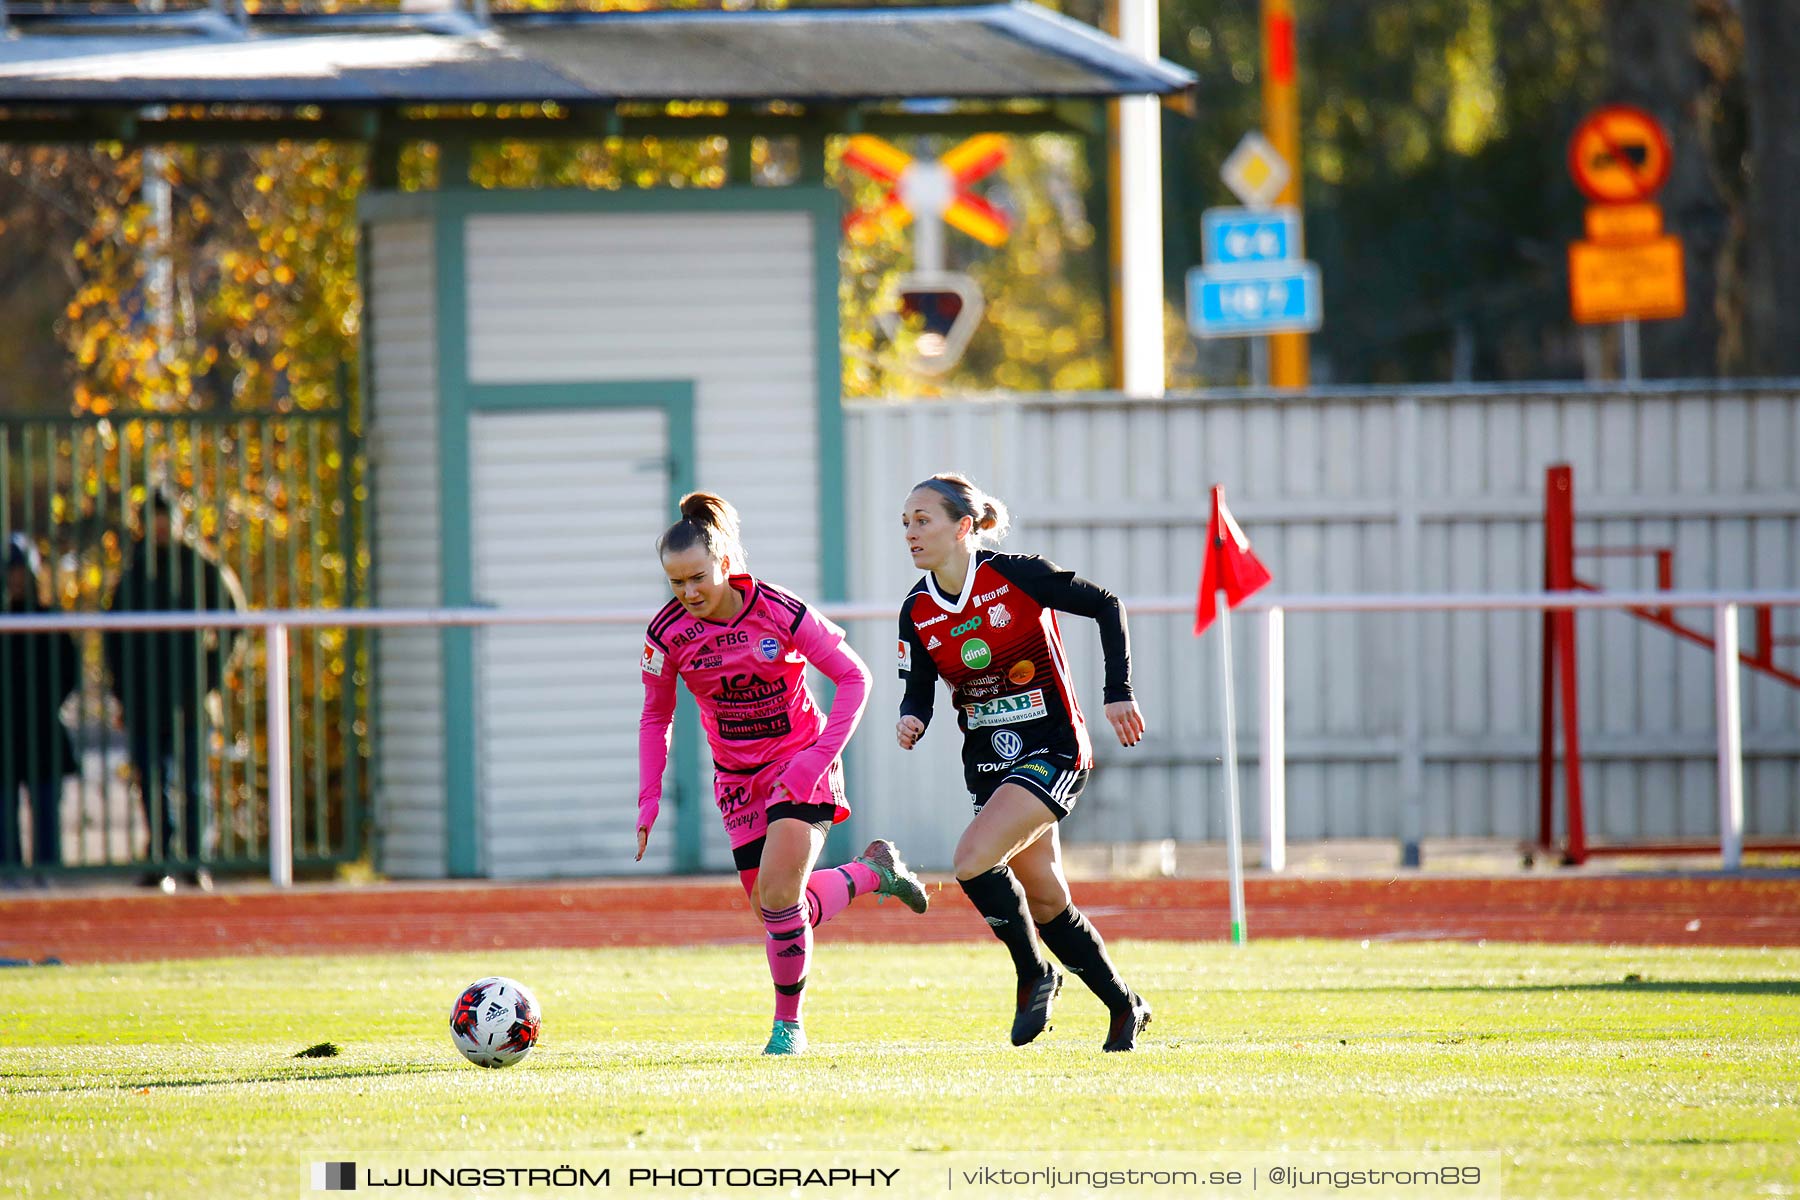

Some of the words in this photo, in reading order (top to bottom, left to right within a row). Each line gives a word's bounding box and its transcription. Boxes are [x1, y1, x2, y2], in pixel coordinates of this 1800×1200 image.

[981, 591, 996, 603] RECO
[950, 615, 982, 637] coop
[671, 622, 705, 648] FABO
[716, 631, 749, 647] FBG
[703, 655, 722, 663] INTER
[964, 646, 988, 662] dina
[720, 673, 769, 693] ICA
[485, 1007, 509, 1022] adidas
